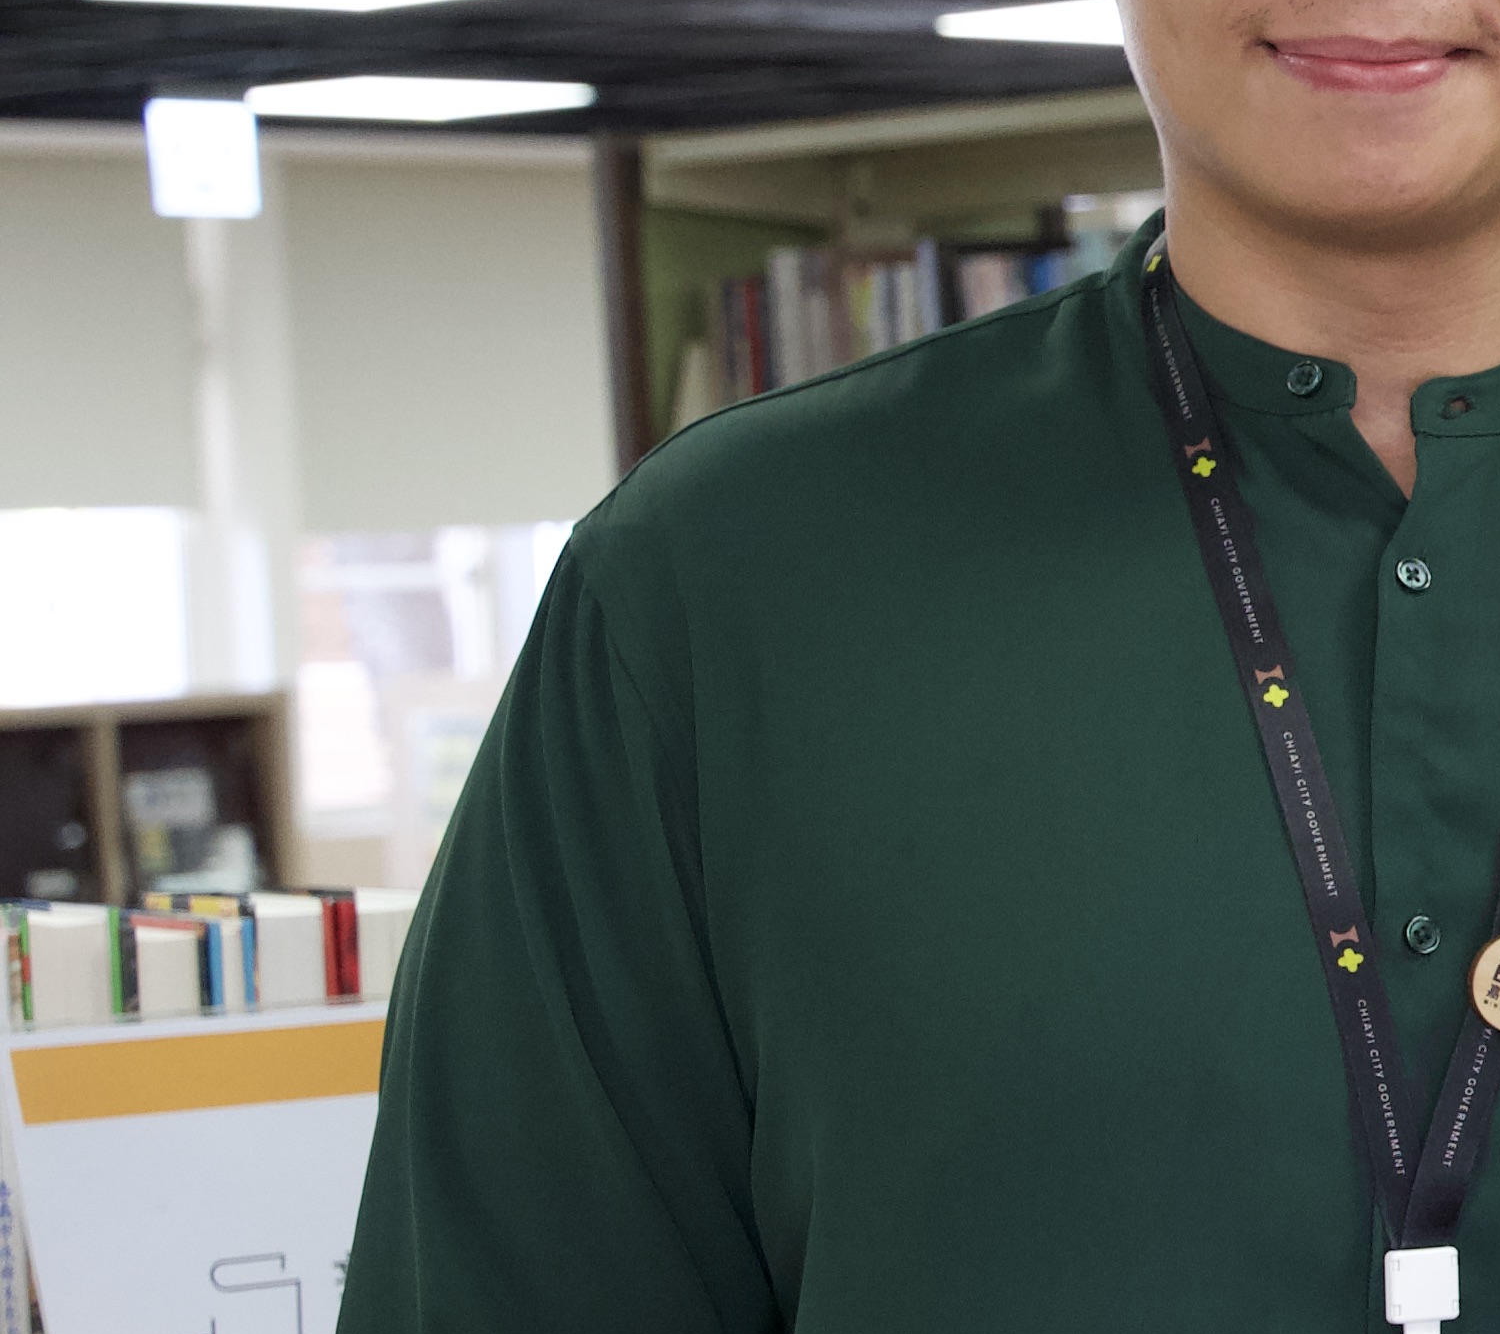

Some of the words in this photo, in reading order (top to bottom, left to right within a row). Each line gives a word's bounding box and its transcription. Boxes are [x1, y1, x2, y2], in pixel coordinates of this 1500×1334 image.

[1210, 497, 1230, 536] CHIAYI
[1223, 538, 1240, 564] CITY
[1232, 567, 1265, 646] GOVERNMENT
[1283, 731, 1302, 774] CHIAYI
[1296, 778, 1312, 807] CITY
[1306, 810, 1339, 899] GOVERNMENT
[1357, 999, 1376, 1044] CHIAYI
[1369, 1048, 1385, 1079] CITY
[1378, 1083, 1406, 1176] GOVERNMENT
[1443, 1078, 1477, 1167] GOVERNMENT
[1472, 1044, 1488, 1075] CITY
